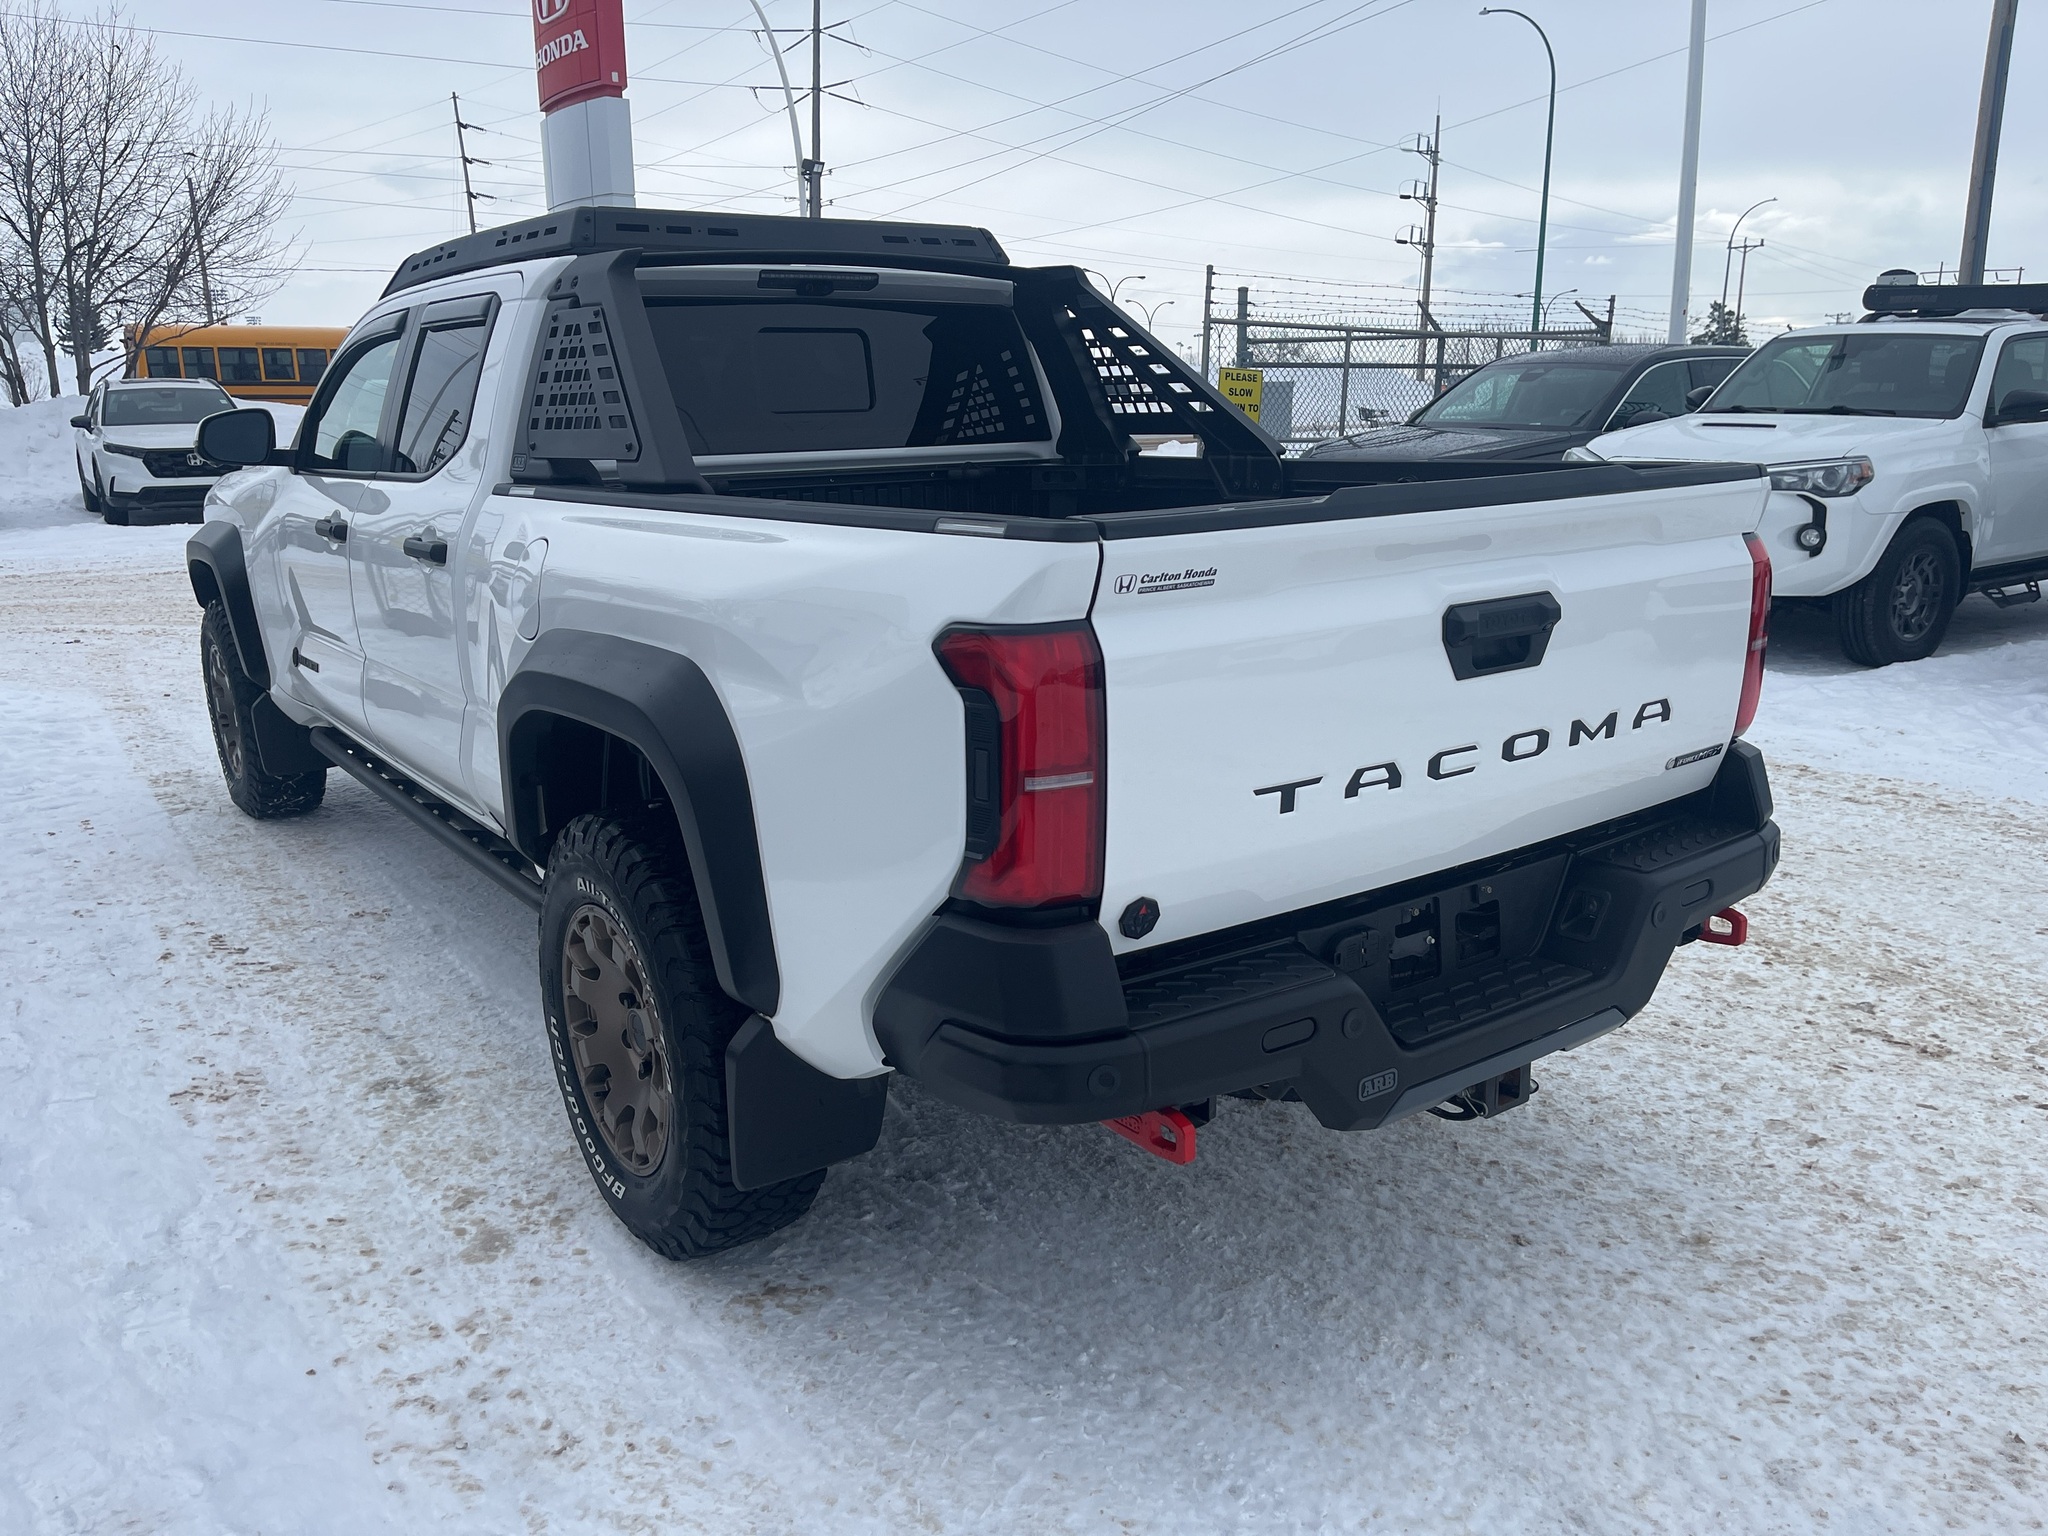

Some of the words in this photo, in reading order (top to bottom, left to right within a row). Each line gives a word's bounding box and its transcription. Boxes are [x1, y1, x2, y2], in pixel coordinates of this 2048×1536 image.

[536, 29, 589, 71] HONDA
[1225, 372, 1258, 382] PLEASE
[1228, 388, 1253, 397] SLOW
[1248, 403, 1259, 413] TO
[1140, 572, 1182, 584] Carlton
[1183, 566, 1218, 580] Honda
[1253, 697, 1672, 814] TACOMA
[1362, 1073, 1395, 1098] ARB
